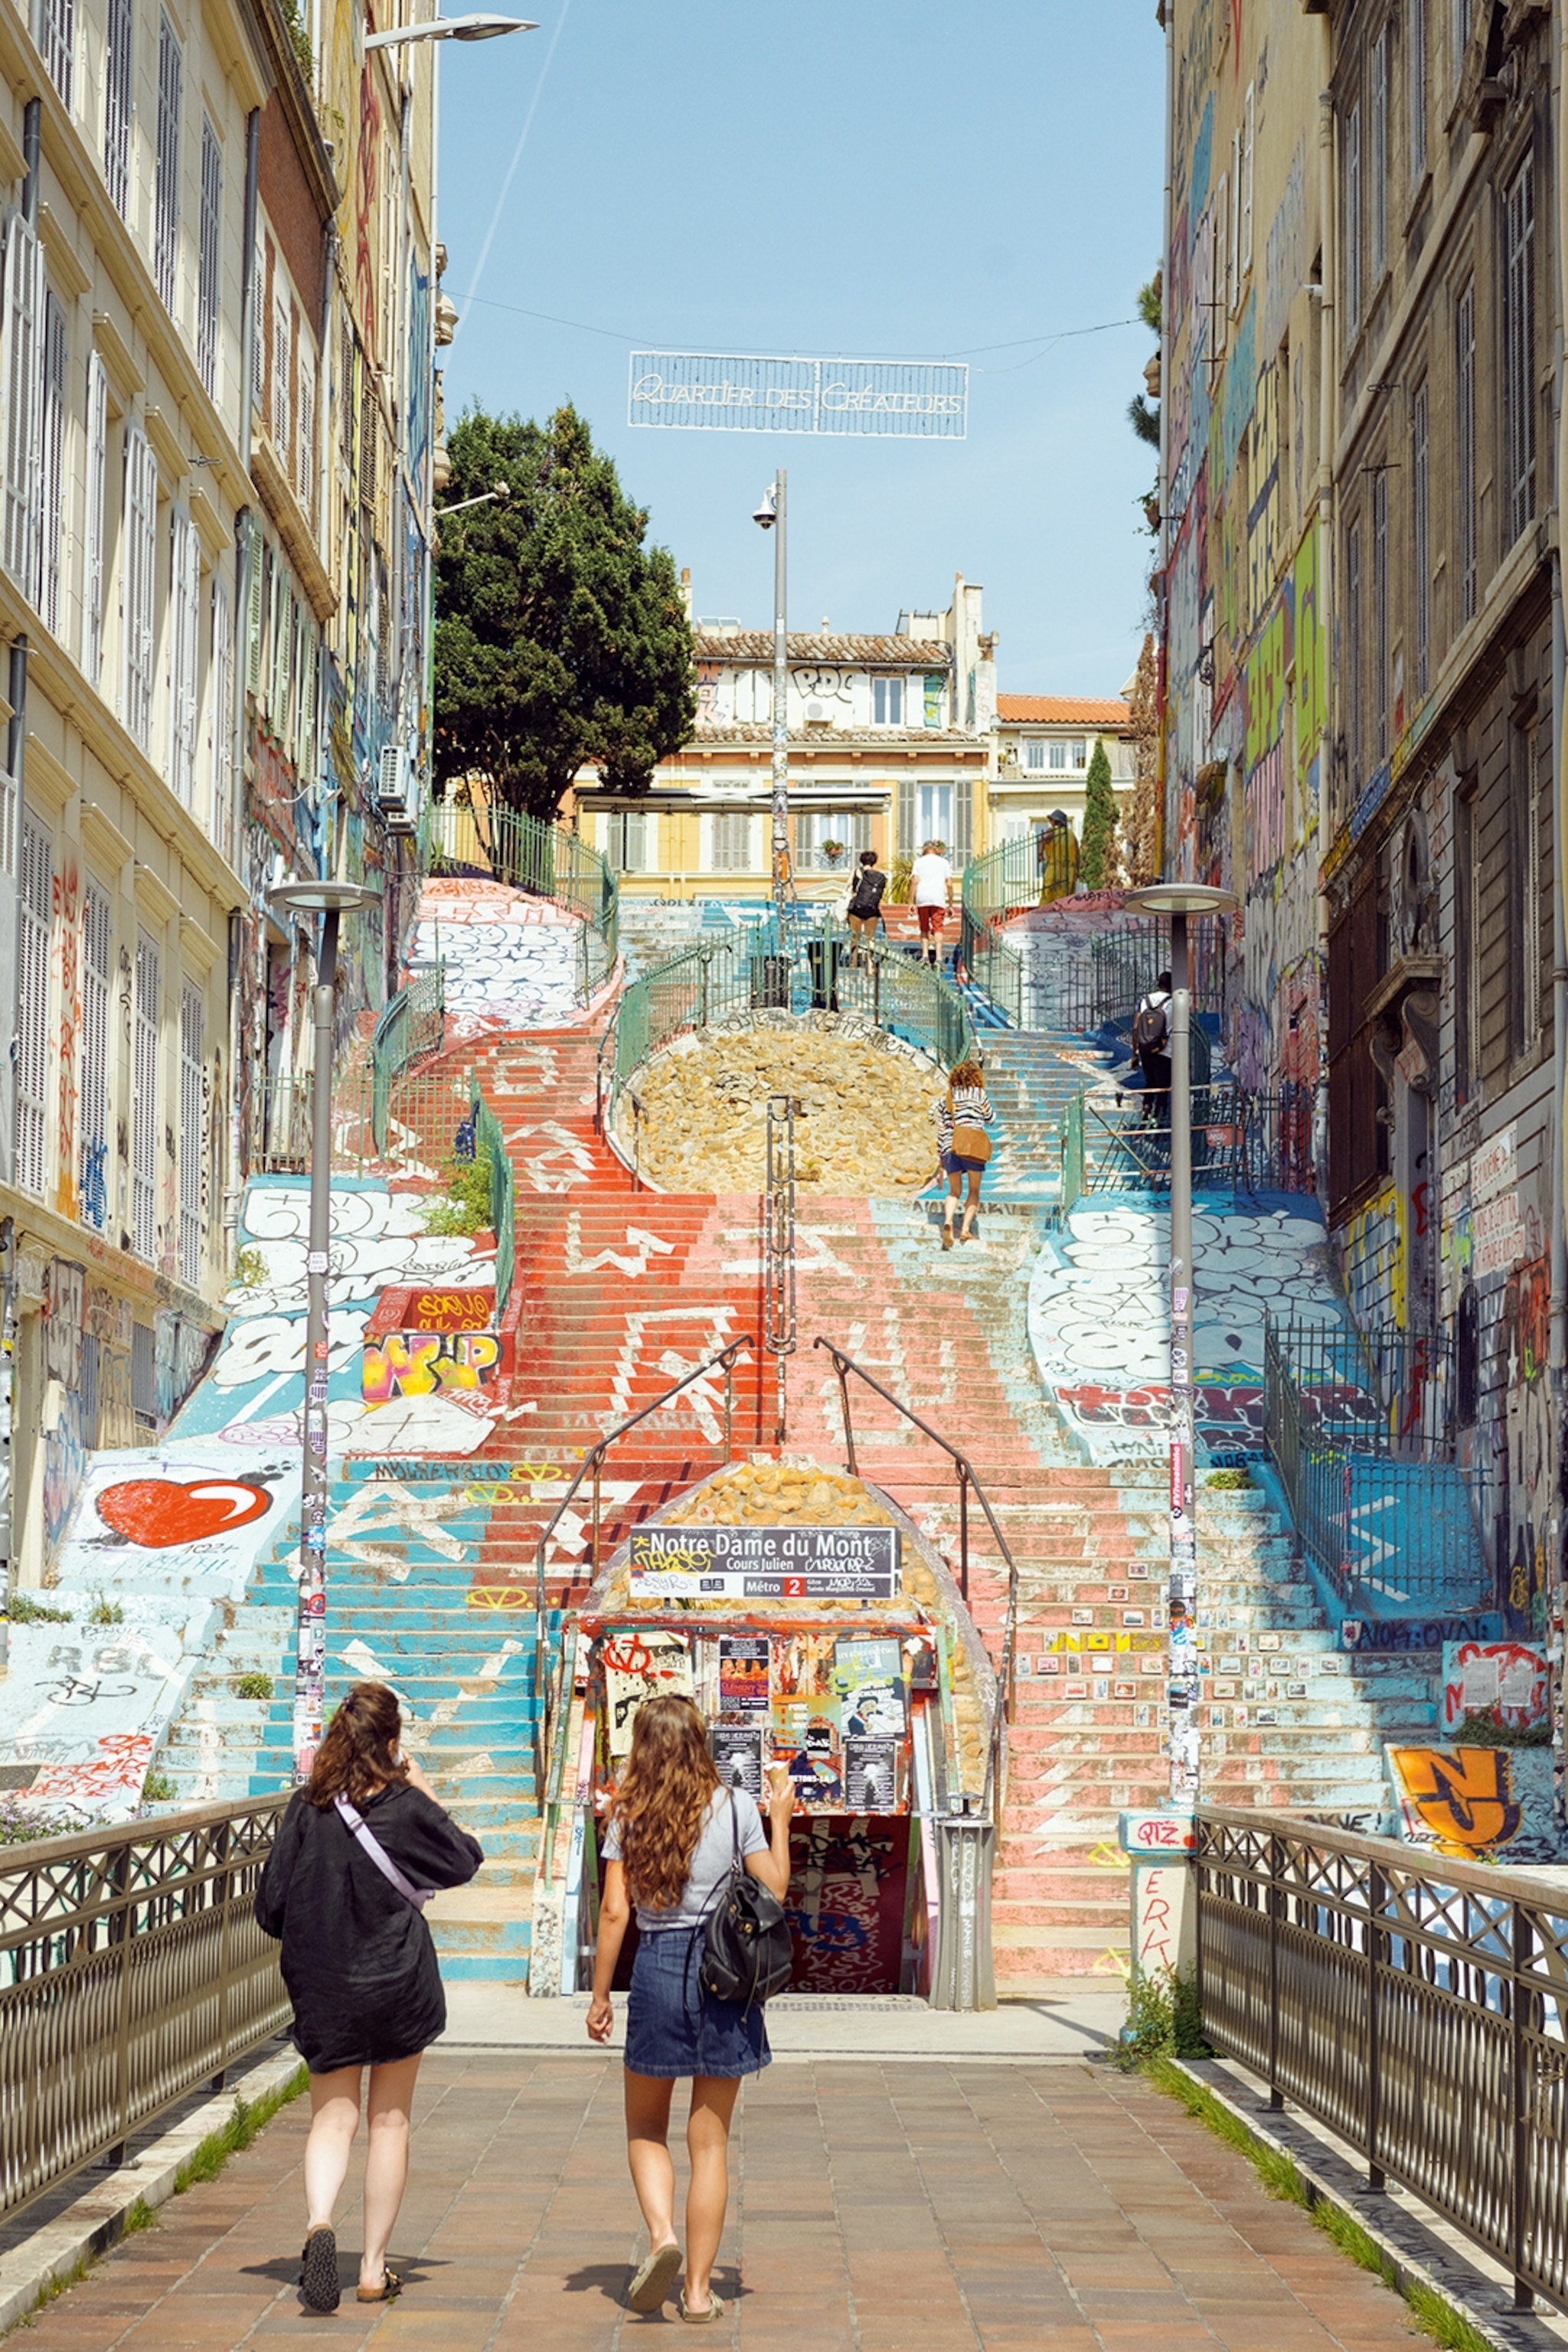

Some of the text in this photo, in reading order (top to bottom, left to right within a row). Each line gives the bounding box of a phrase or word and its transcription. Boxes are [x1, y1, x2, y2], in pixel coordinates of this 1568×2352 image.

[651, 1532, 873, 1557] Notre Dame du Mont
[726, 1557, 759, 1571] Cours
[762, 1557, 794, 1571] Julien
[746, 1579, 781, 1593] Métro
[789, 1579, 801, 1594] 2
